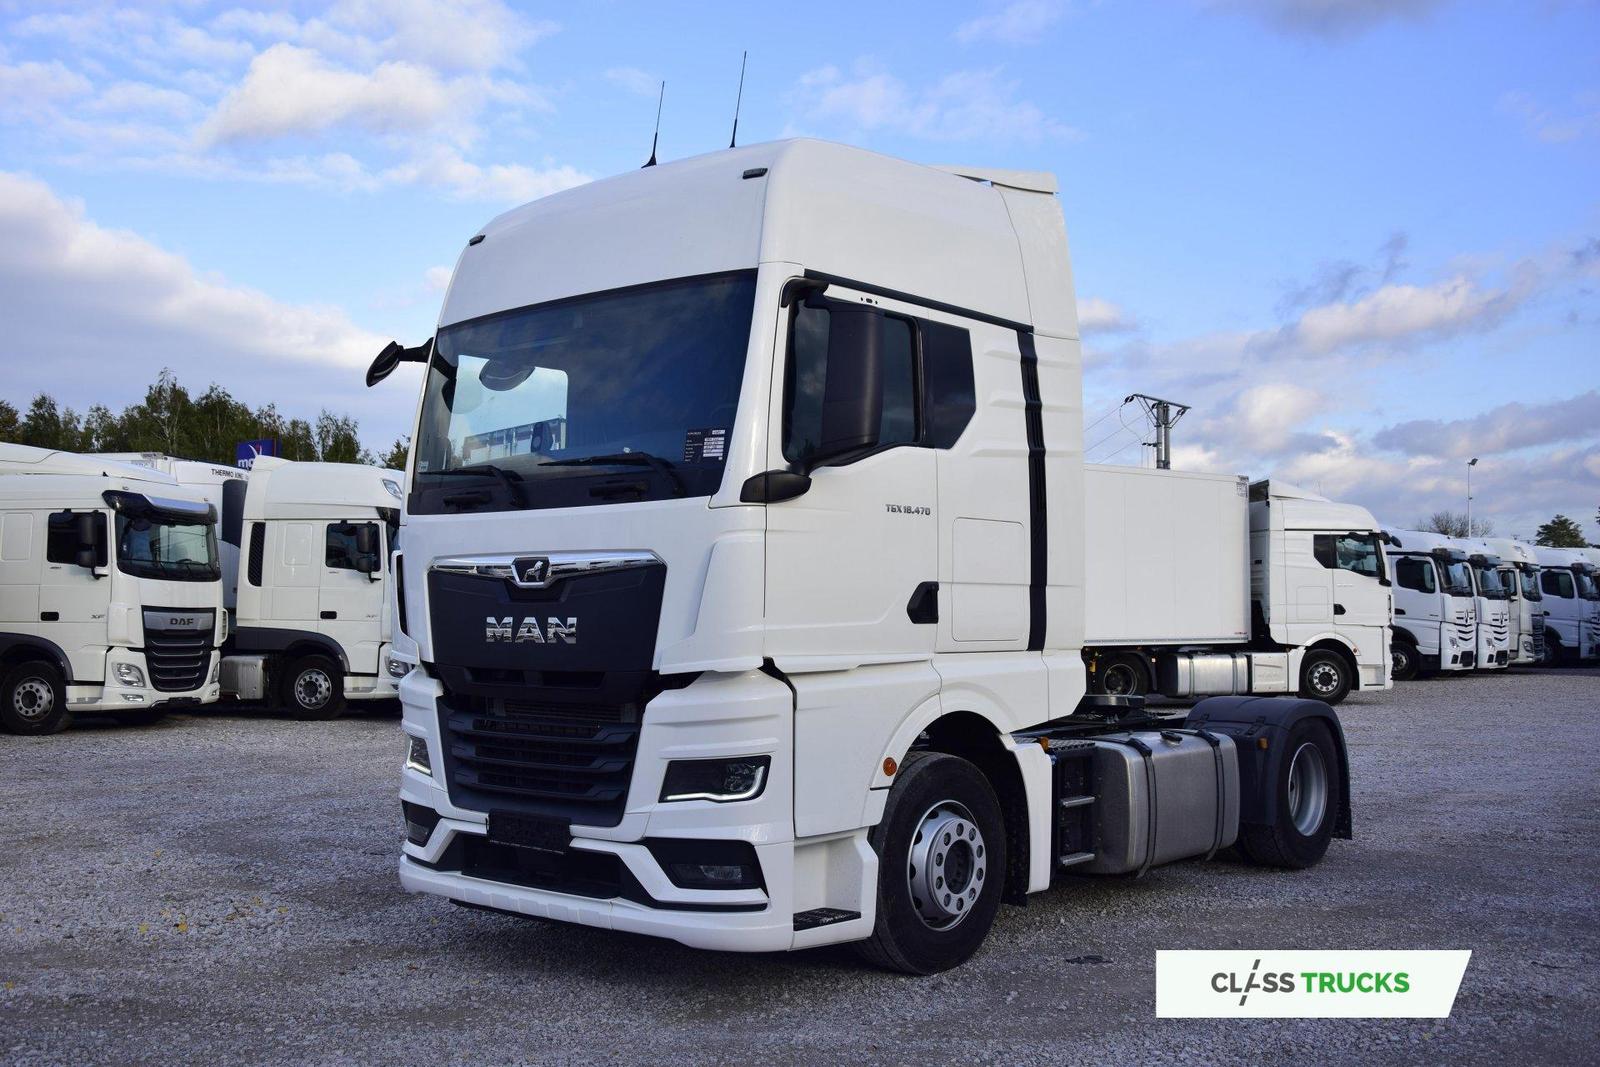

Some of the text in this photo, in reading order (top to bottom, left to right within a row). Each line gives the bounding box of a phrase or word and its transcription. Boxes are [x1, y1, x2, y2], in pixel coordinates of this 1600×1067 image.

[211, 468, 234, 478] THERMO
[885, 504, 931, 516] TGX 18.470
[170, 617, 194, 626] DAF
[486, 616, 578, 644] MAN
